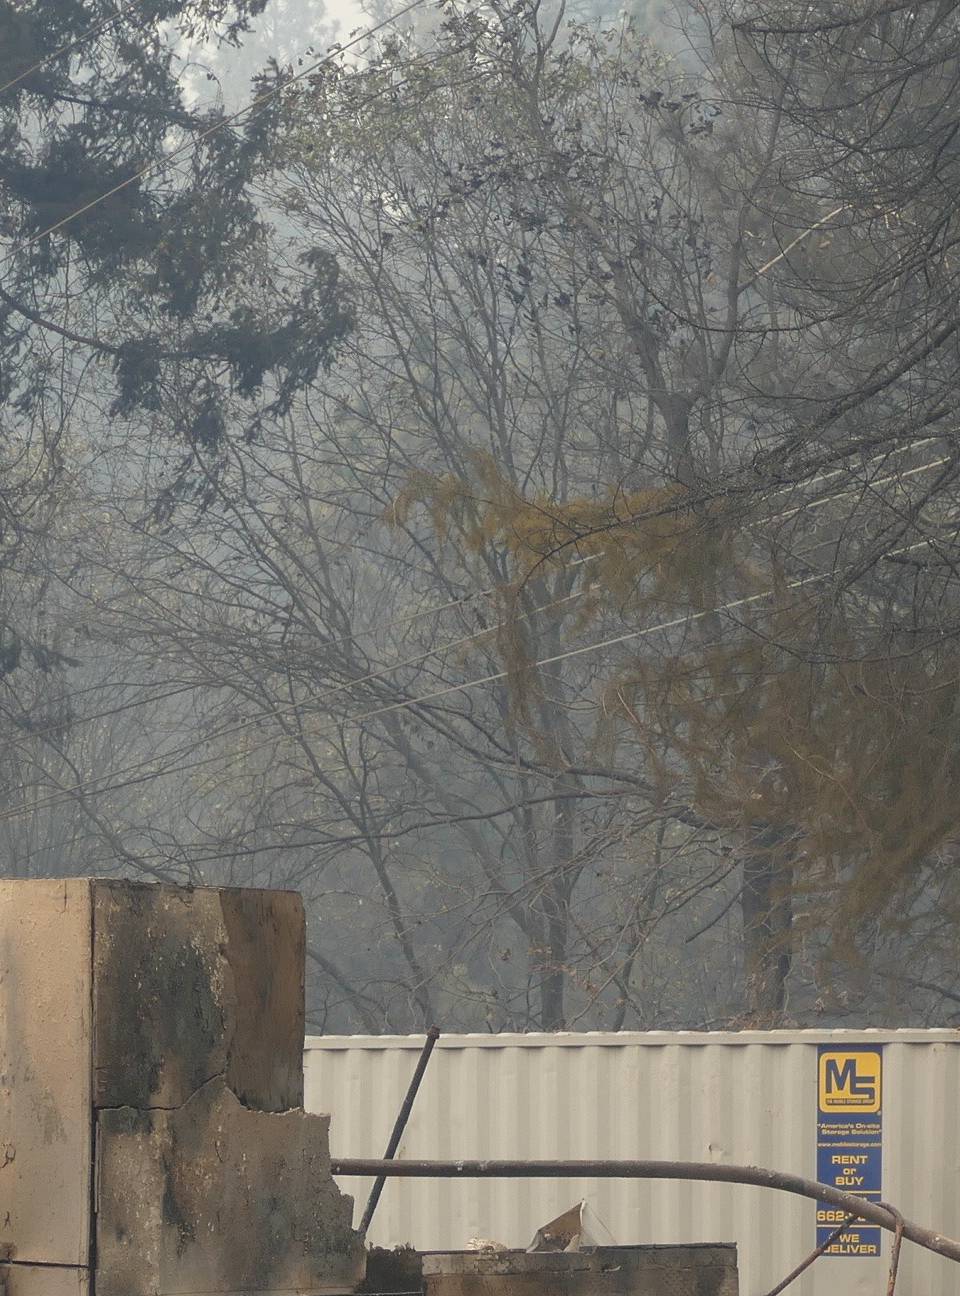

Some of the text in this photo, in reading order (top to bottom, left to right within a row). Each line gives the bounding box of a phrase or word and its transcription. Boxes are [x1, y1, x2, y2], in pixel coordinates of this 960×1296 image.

[832, 1155, 868, 1164] RENT
[835, 1176, 864, 1185] BUY
[839, 1234, 860, 1242] WE
